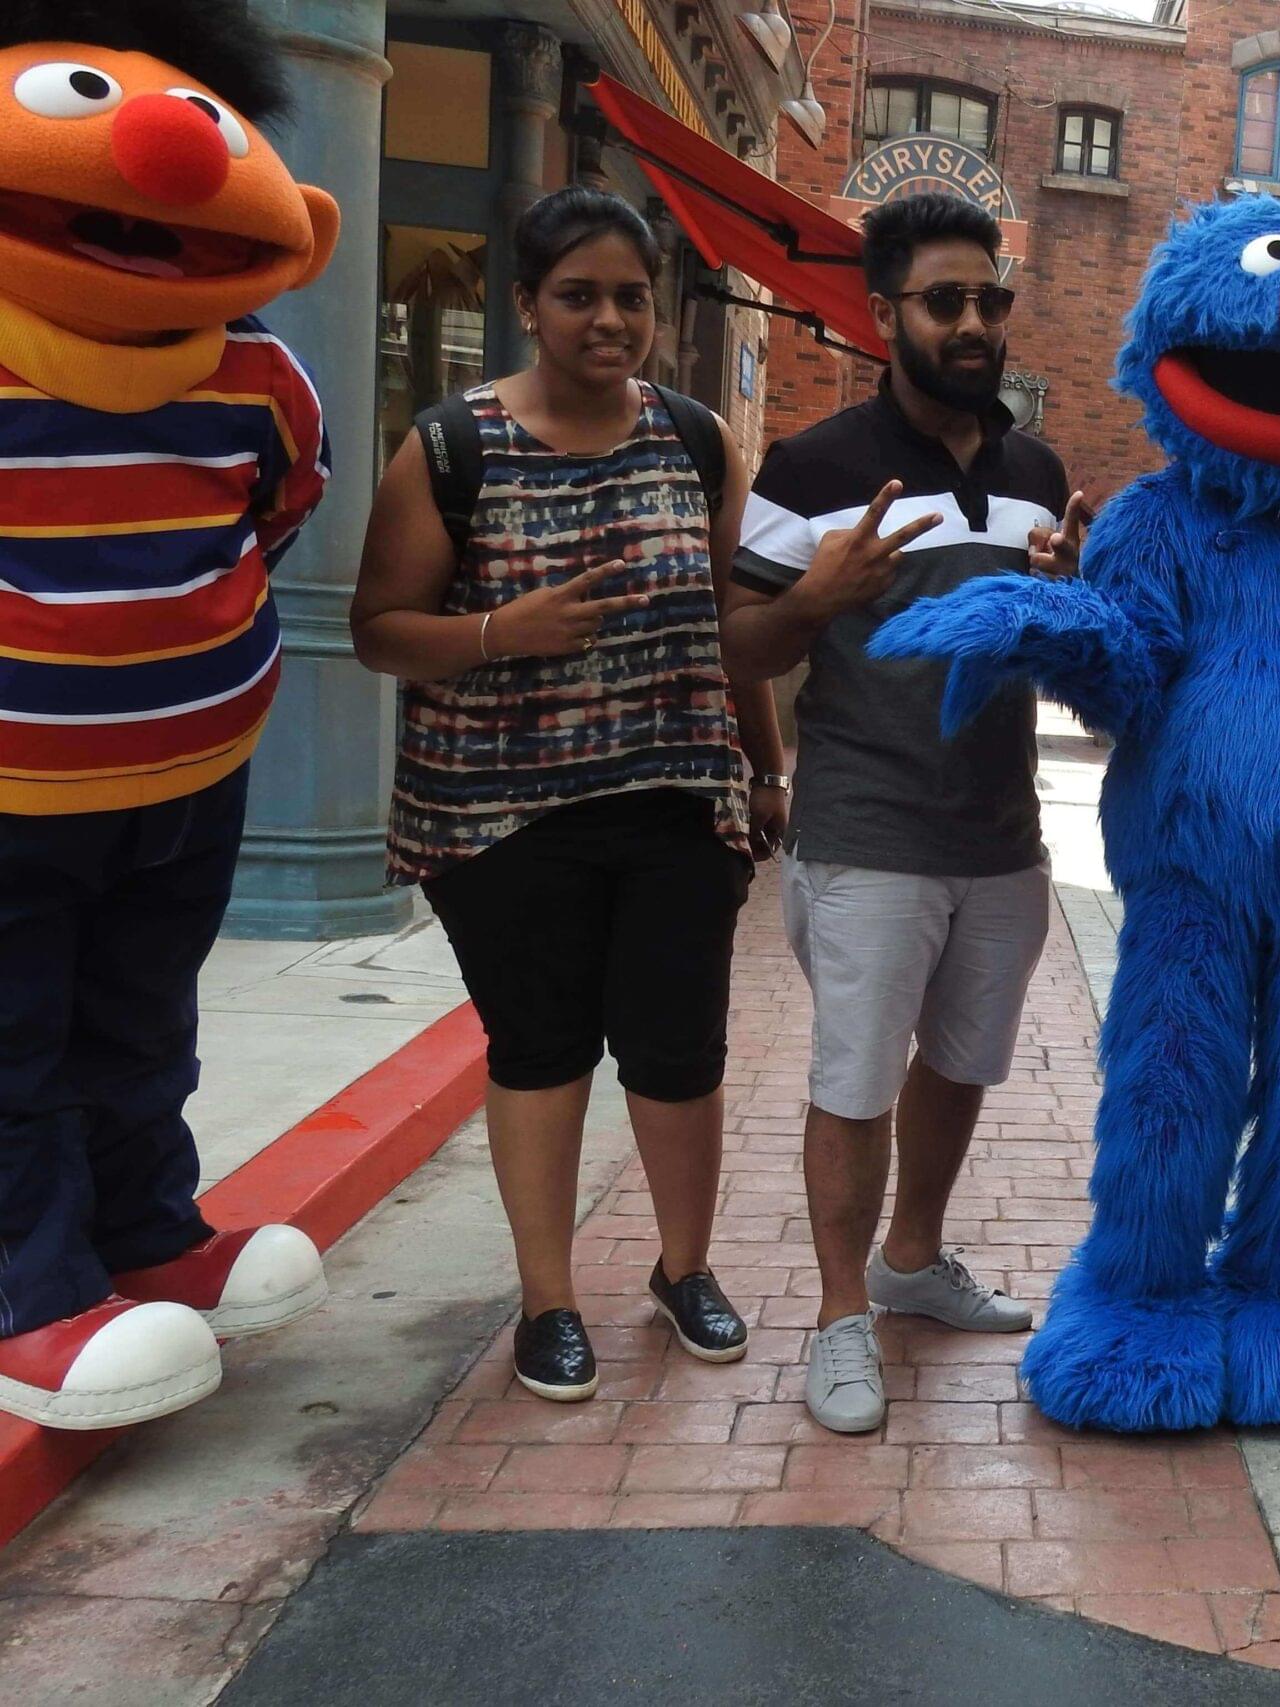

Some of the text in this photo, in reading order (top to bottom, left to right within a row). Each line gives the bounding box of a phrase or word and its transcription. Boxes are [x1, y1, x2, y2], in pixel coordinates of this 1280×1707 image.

[857, 144, 1004, 213] CHRYSLER
[428, 423, 445, 473] TOURISTER
[434, 422, 451, 473] AMERICAN
